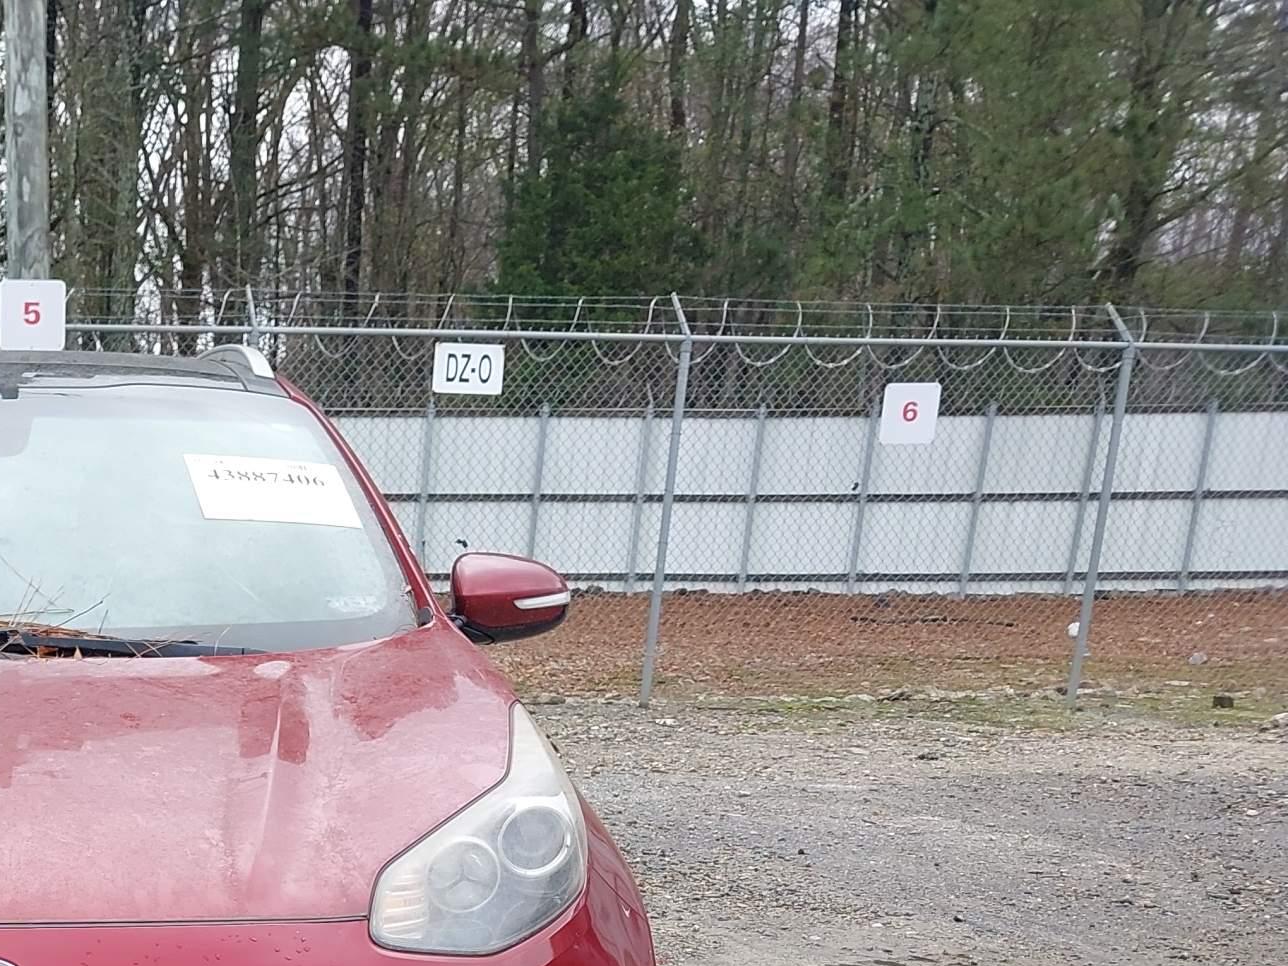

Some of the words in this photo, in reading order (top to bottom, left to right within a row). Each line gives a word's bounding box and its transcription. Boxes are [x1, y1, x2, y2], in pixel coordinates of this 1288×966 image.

[23, 302, 41, 325] 5
[902, 401, 918, 422] 6
[207, 468, 326, 487] 43887406
